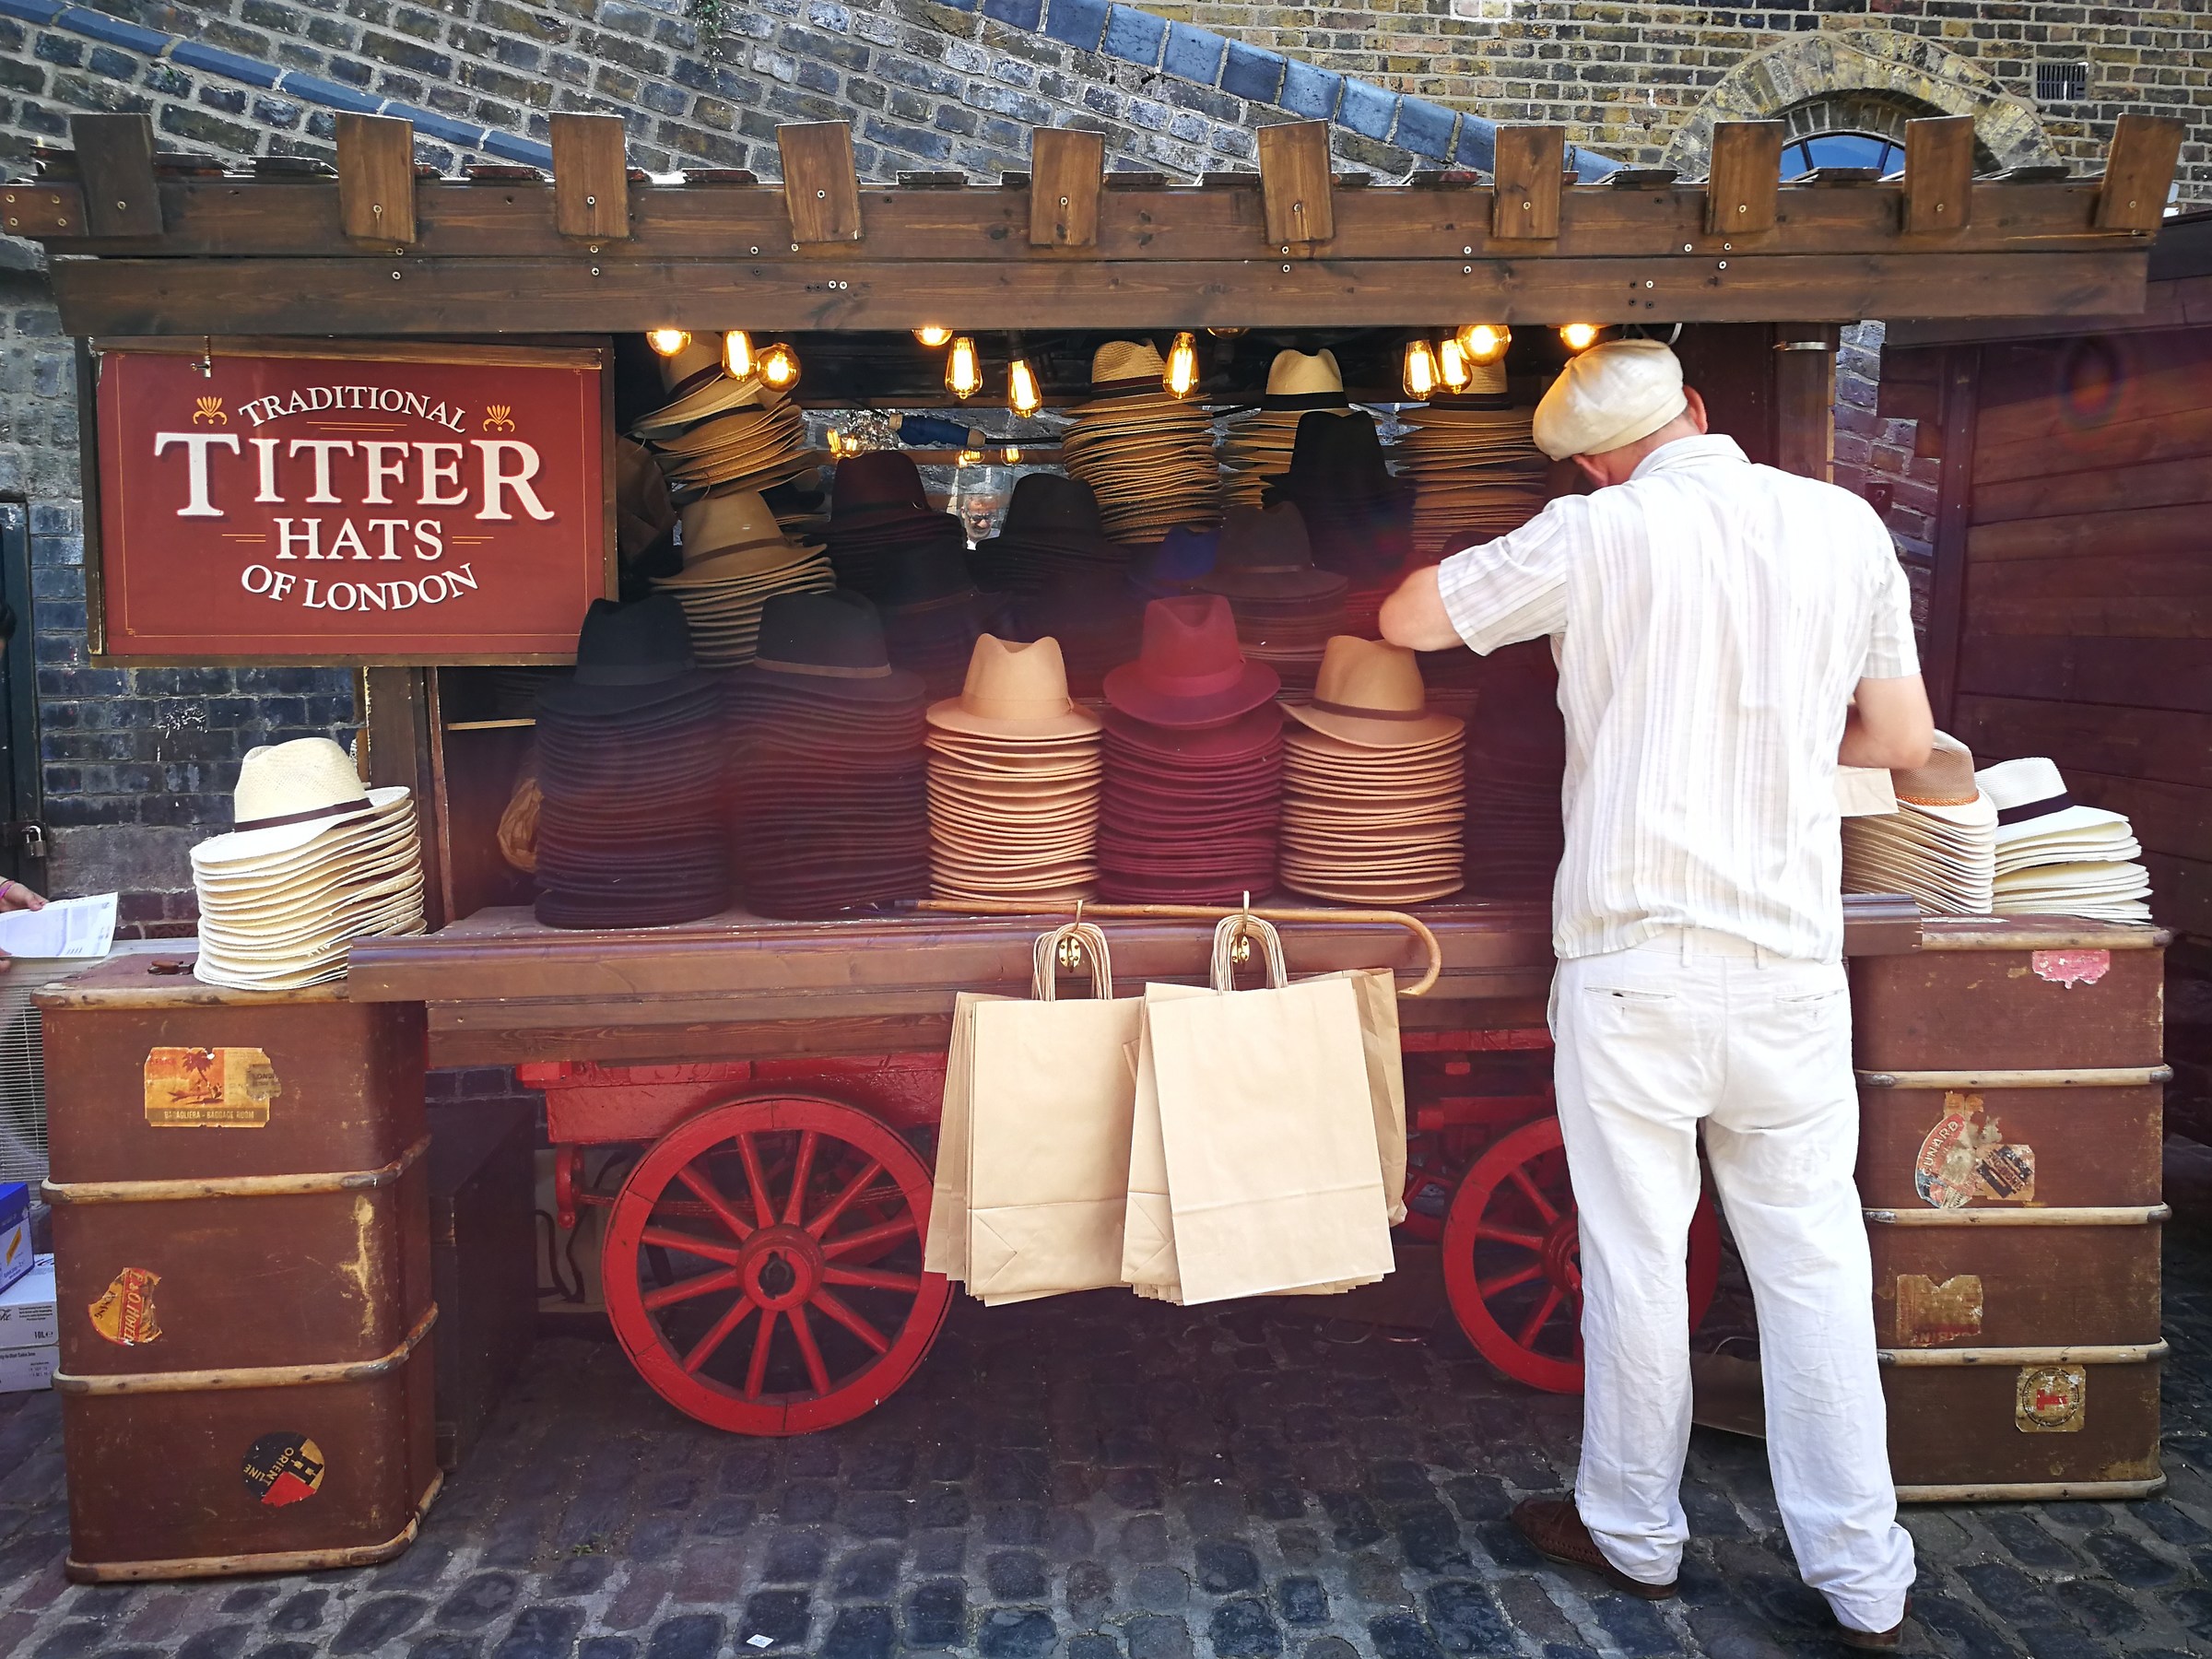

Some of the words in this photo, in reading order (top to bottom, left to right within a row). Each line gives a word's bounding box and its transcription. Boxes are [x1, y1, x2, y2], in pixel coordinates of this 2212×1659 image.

[239, 385, 465, 433] TRADITIONAL
[155, 432, 555, 521] TITFER
[273, 518, 443, 560] HATS
[241, 564, 297, 601] OF
[302, 563, 478, 611] LONDON
[1923, 1121, 1959, 1176] CUNARD
[243, 1464, 265, 1481] LINE
[264, 1447, 294, 1486] ORIENT
